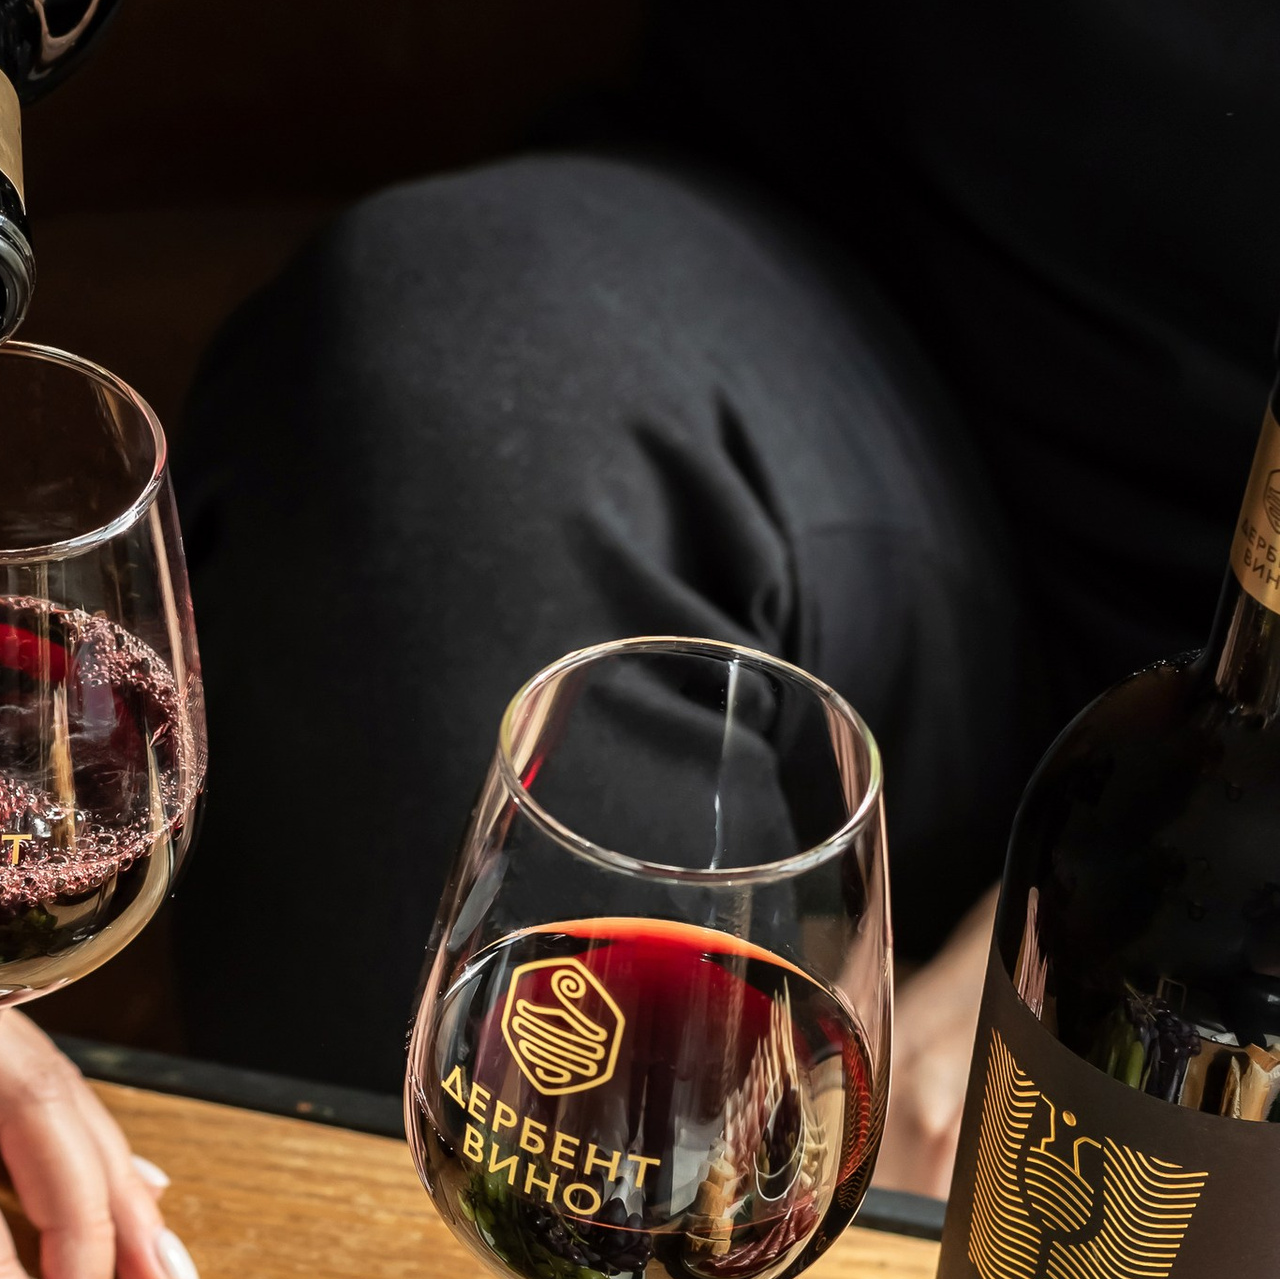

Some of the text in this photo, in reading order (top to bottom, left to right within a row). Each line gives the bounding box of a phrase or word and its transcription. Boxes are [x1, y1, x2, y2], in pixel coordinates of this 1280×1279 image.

[1241, 518, 1280, 567] ДЕРБ
[440, 1064, 662, 1189] ДЕРБЕНТ
[462, 1123, 603, 1216] ВИНО
